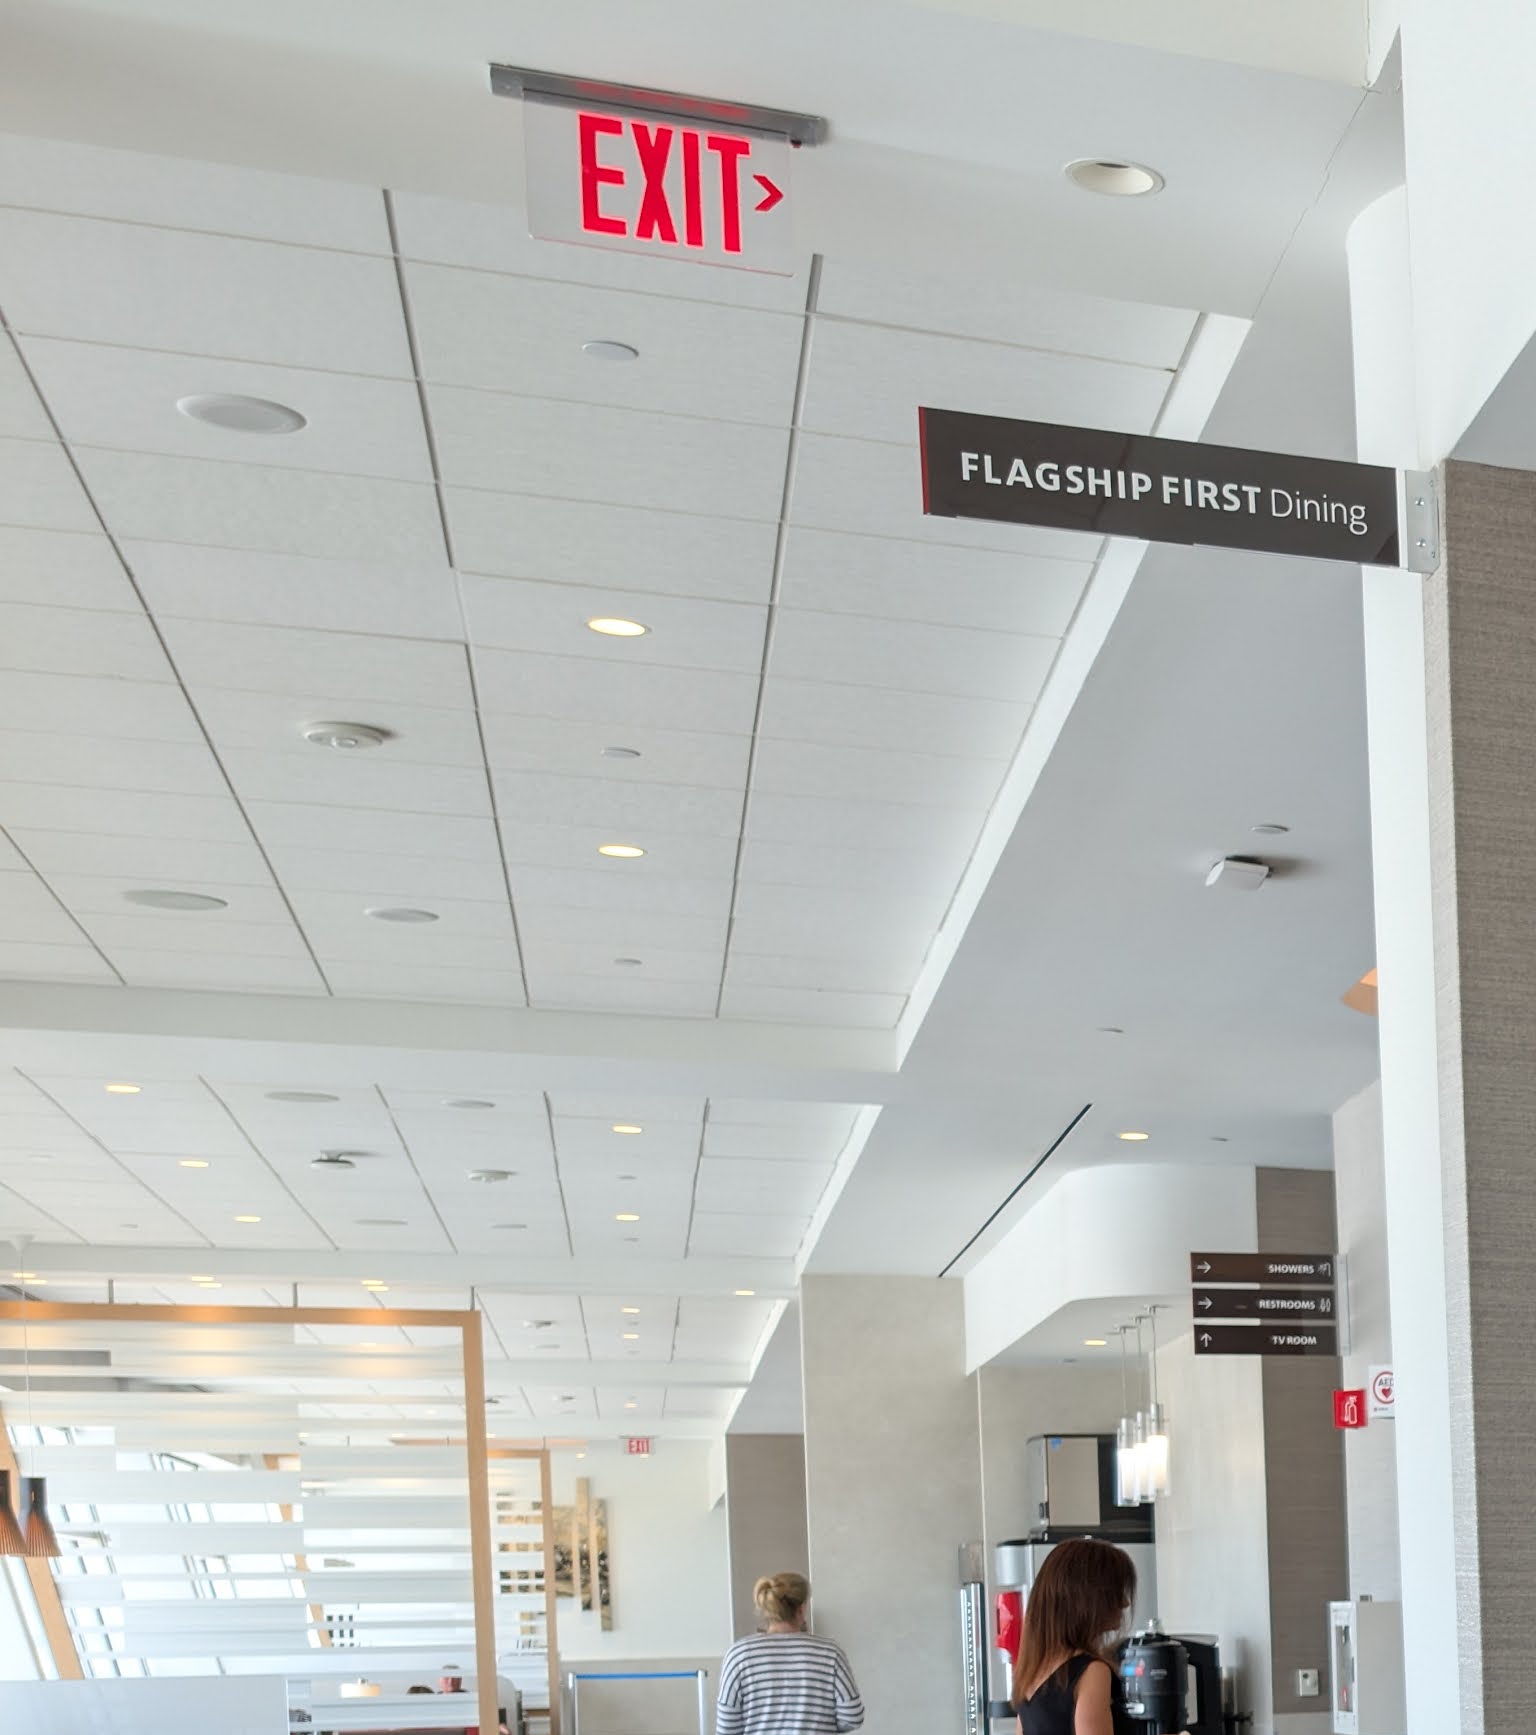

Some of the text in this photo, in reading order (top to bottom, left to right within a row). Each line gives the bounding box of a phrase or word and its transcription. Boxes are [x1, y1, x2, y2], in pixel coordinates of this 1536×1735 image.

[577, 112, 751, 254] EXIT
[960, 451, 1368, 535] FLAGSHIP FIRST Dining
[1268, 1264, 1315, 1274] SHOWERS
[1259, 1299, 1316, 1310] RESTROOMS
[1272, 1335, 1317, 1345] TV ROOM
